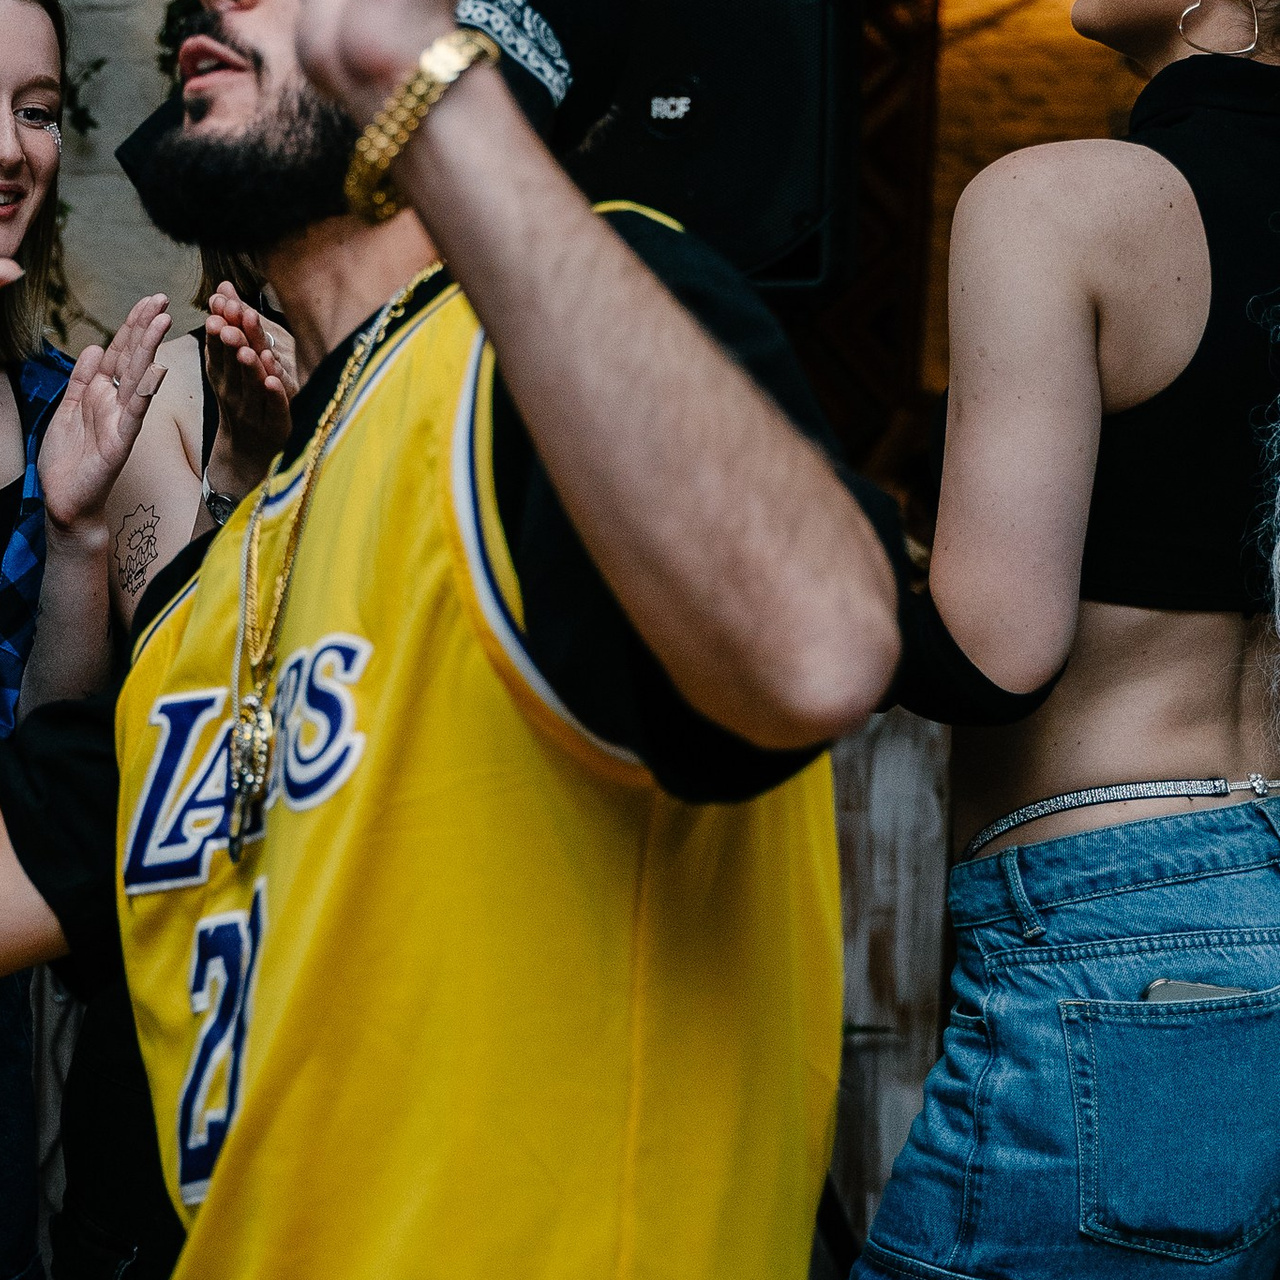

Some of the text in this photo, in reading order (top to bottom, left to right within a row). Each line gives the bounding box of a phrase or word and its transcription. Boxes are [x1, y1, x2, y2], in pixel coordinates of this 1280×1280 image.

[650, 96, 692, 120] RCF
[124, 633, 373, 895] LAS
[178, 876, 268, 1206] 2
